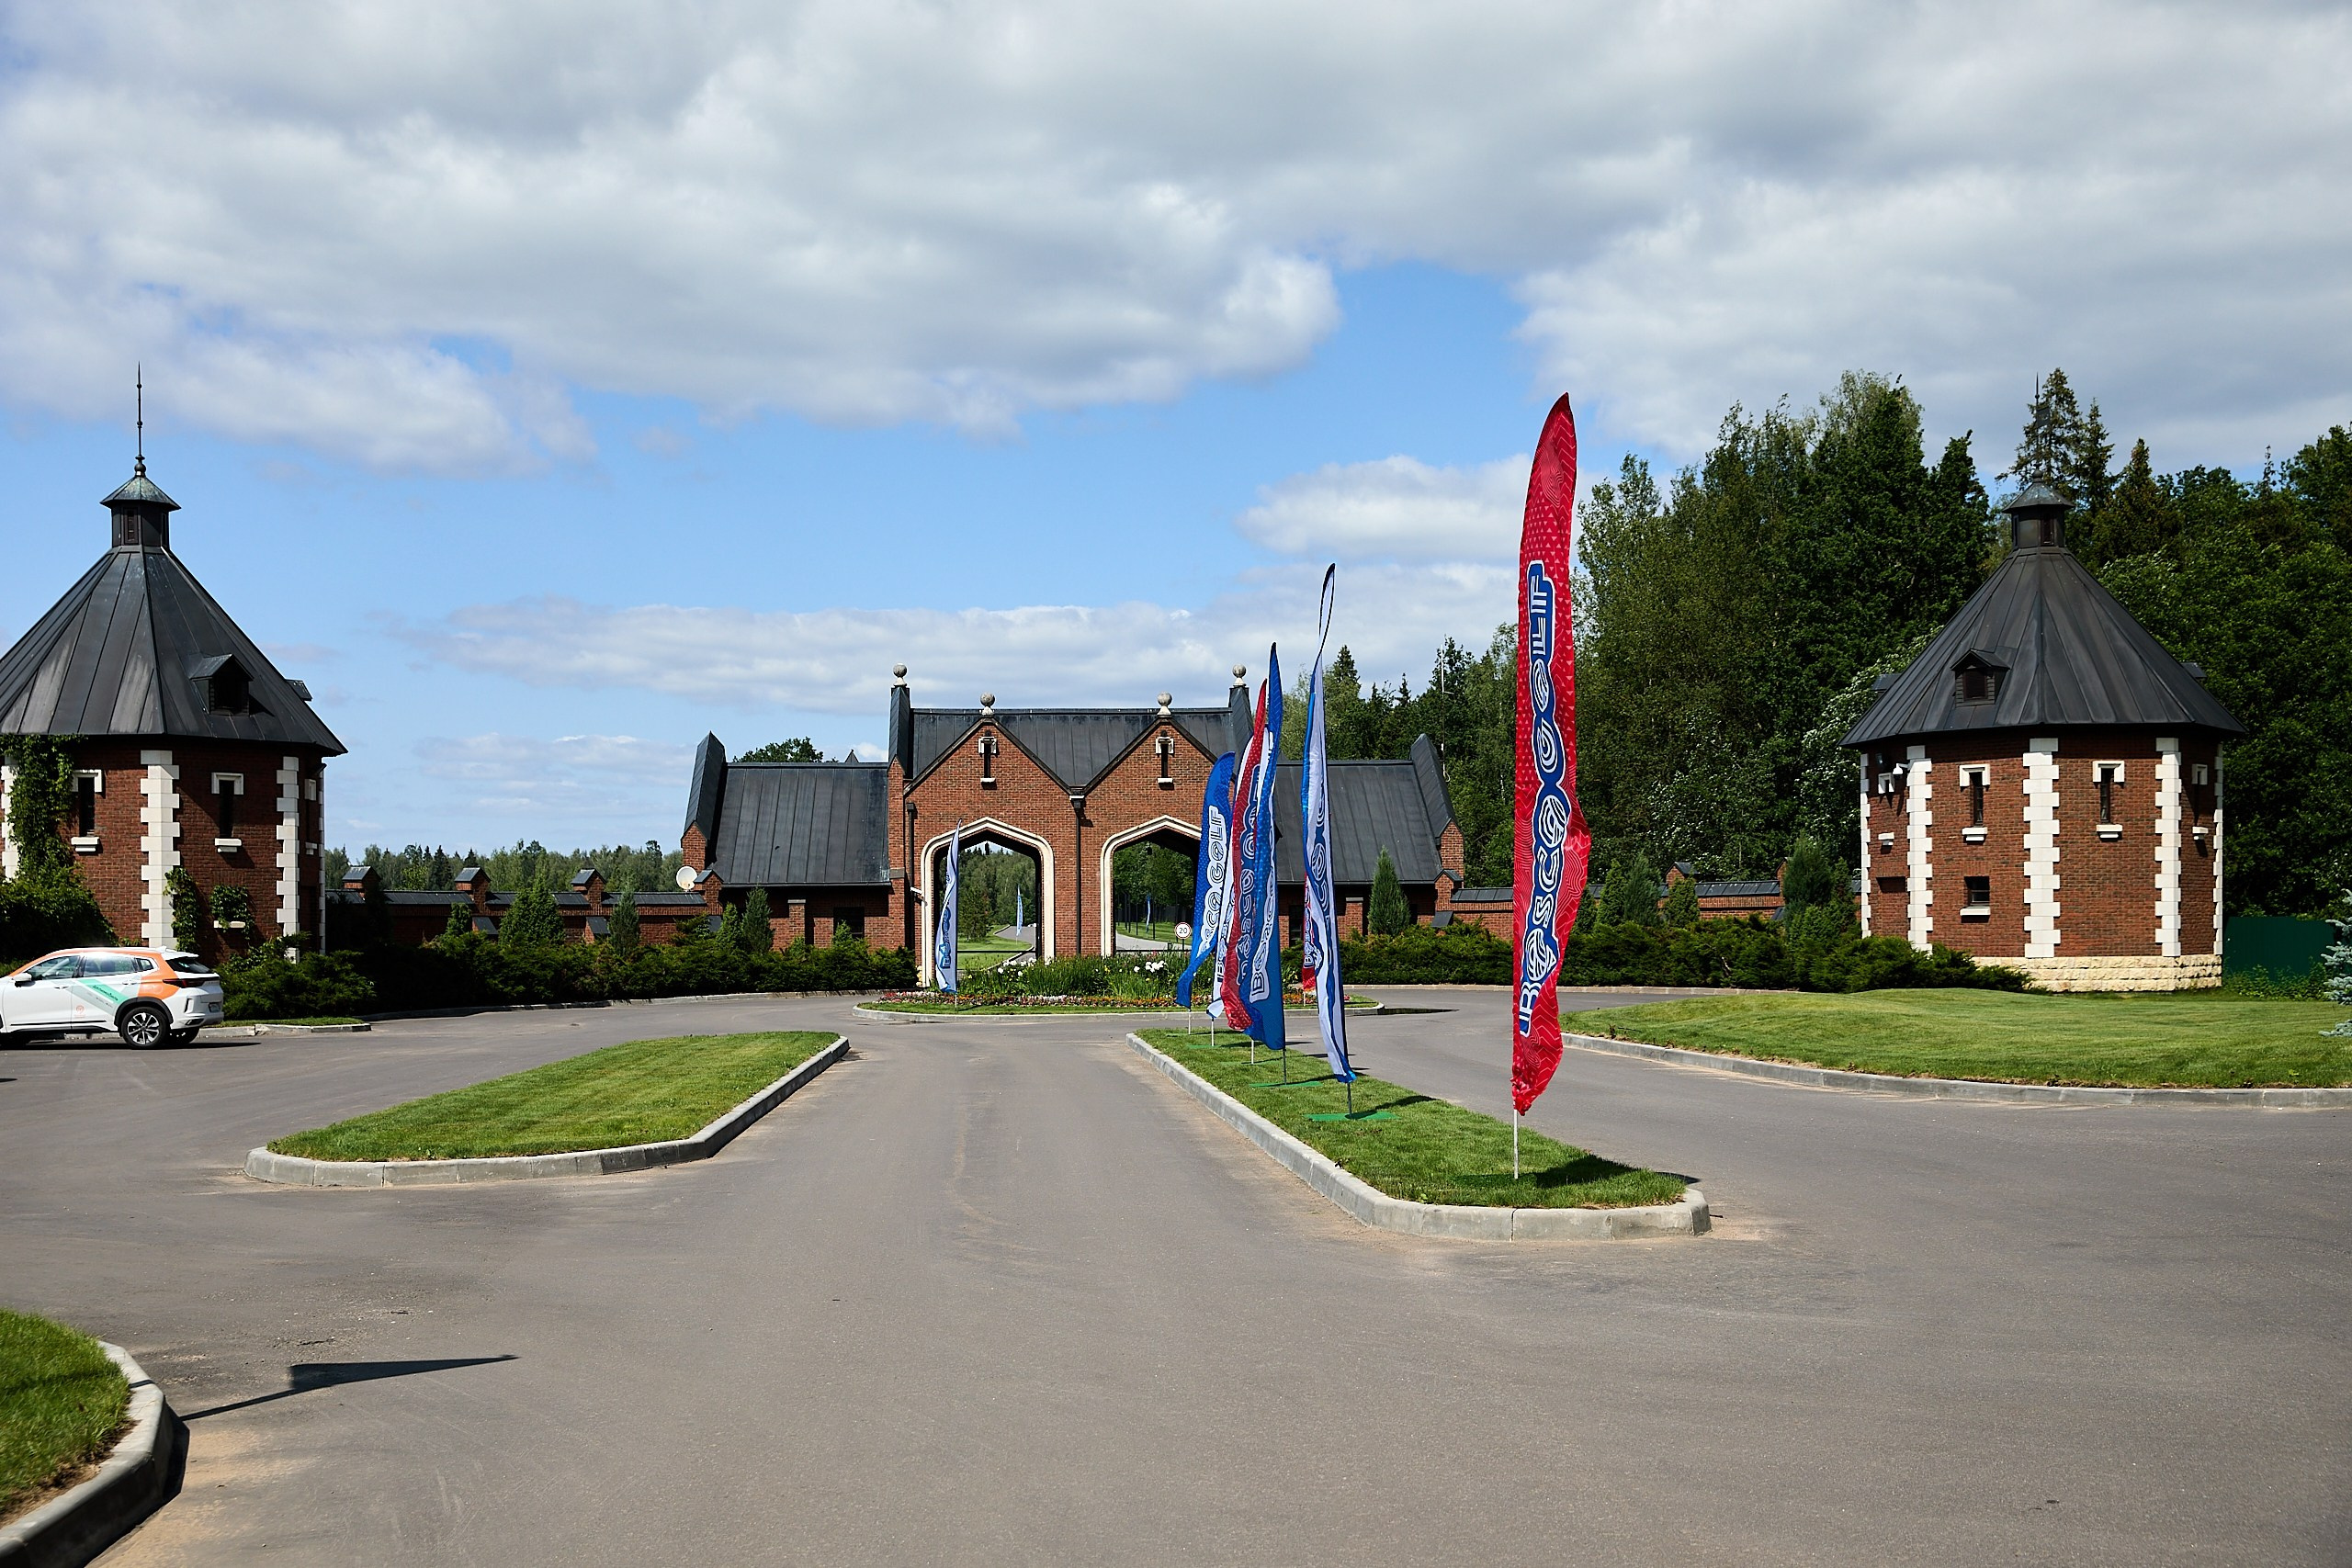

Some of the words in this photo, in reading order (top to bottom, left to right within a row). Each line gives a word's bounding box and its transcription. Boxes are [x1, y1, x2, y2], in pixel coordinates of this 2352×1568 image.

[1530, 577, 1560, 774] GOLF
[1208, 807, 1225, 883] GOLF
[1520, 794, 1568, 1034] BOSCO
